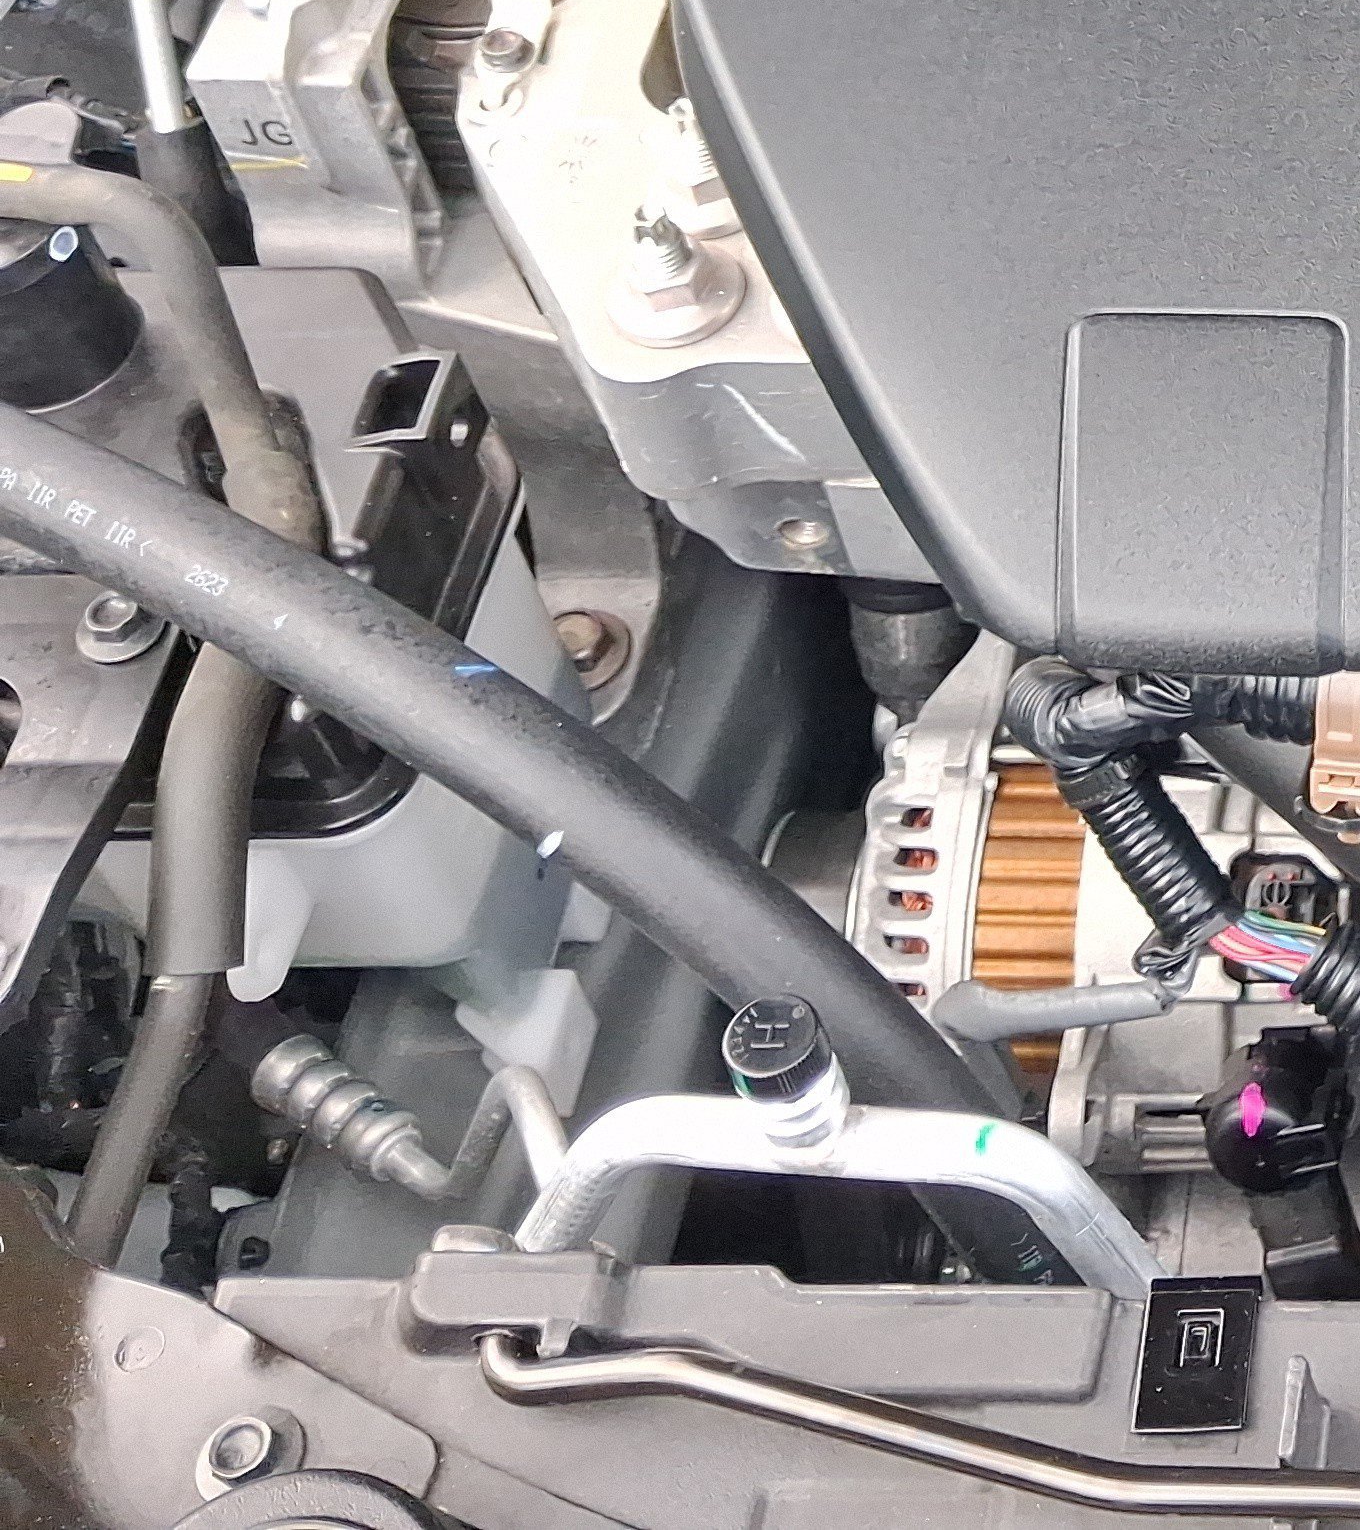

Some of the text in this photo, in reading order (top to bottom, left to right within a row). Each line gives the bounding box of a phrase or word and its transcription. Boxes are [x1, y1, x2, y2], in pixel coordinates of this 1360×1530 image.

[242, 119, 293, 146] JG
[63, 499, 97, 527] PET
[750, 1023, 790, 1049] H
